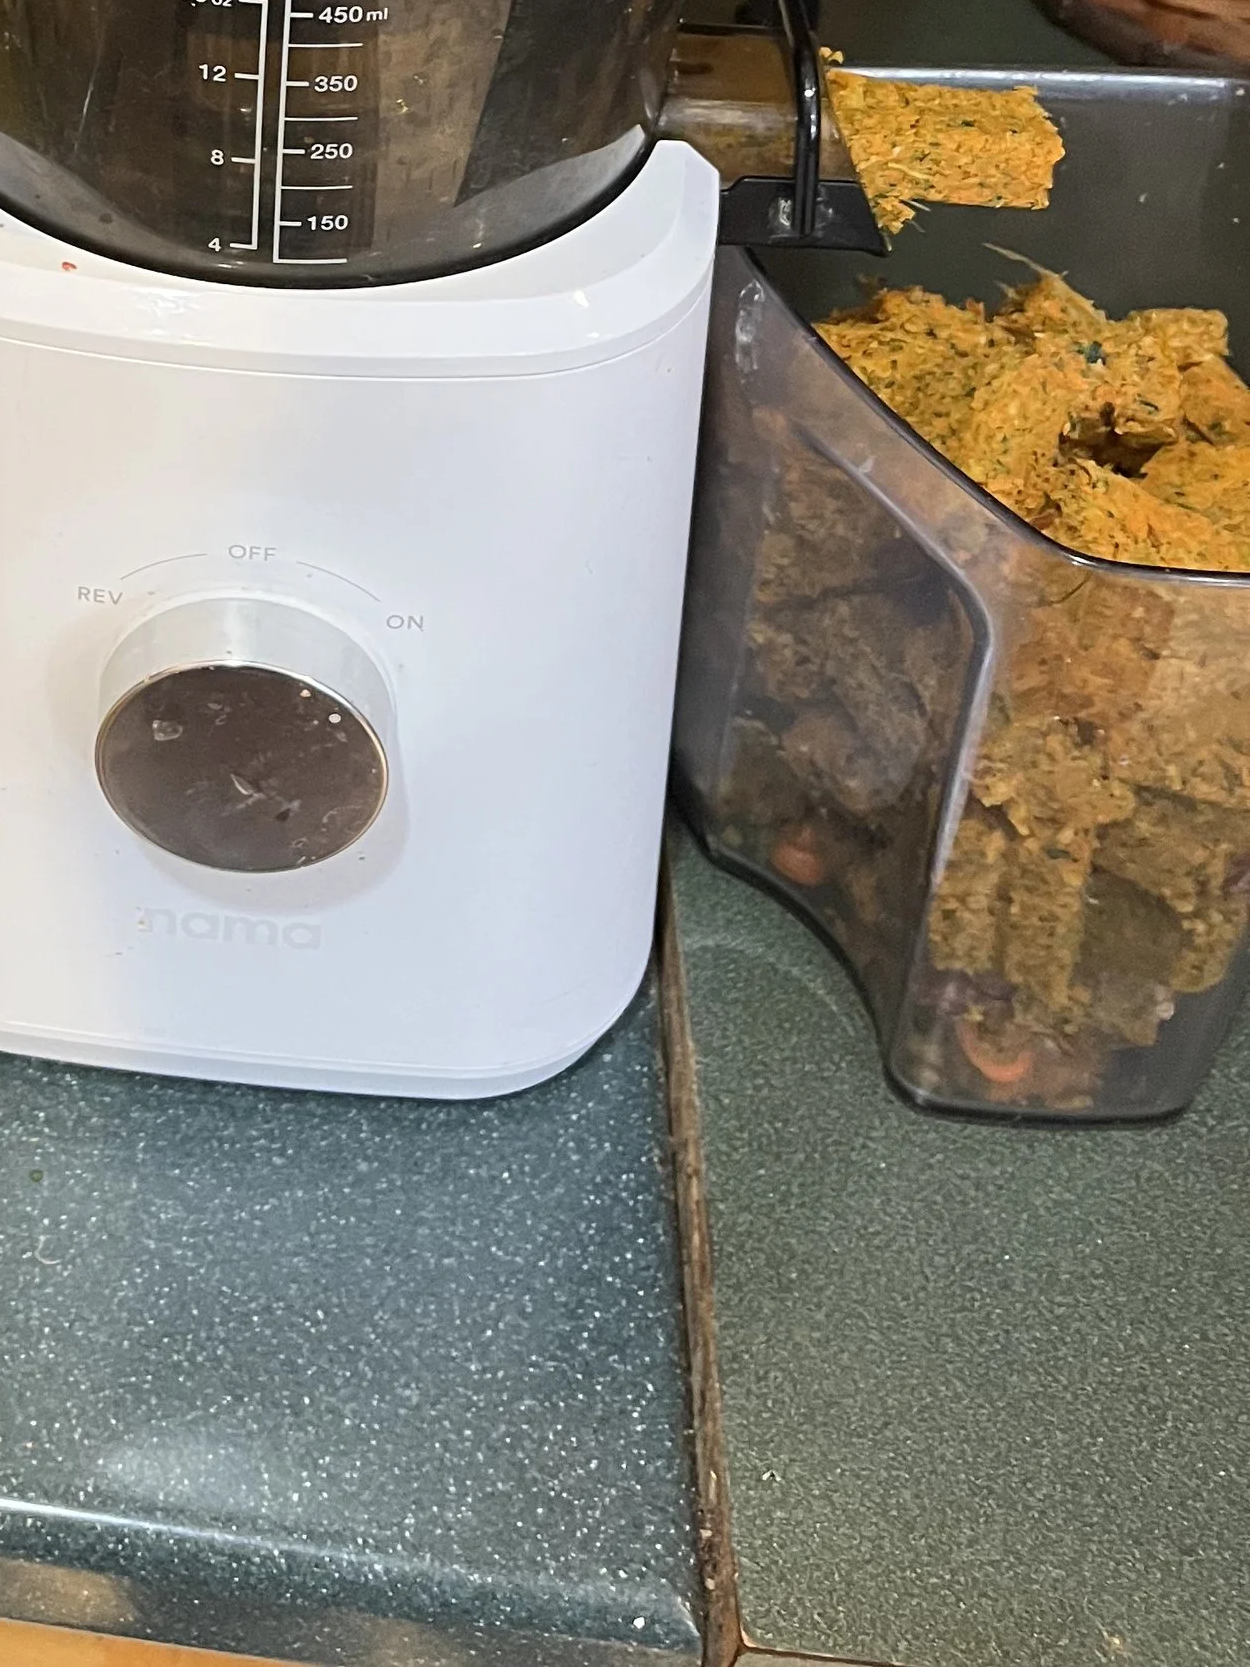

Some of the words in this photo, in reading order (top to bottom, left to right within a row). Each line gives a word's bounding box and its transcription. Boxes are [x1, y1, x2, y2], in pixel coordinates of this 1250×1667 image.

[318, 6, 363, 24] 450
[366, 7, 389, 21] ml
[199, 64, 227, 82] 12
[314, 75, 358, 92] 350
[210, 149, 224, 165] 8
[310, 142, 353, 159] 250
[307, 215, 349, 231] 150
[208, 237, 221, 251] 4
[228, 544, 277, 561] OFF
[77, 585, 124, 605] REV
[386, 614, 425, 632] ON
[144, 908, 322, 950] nama
